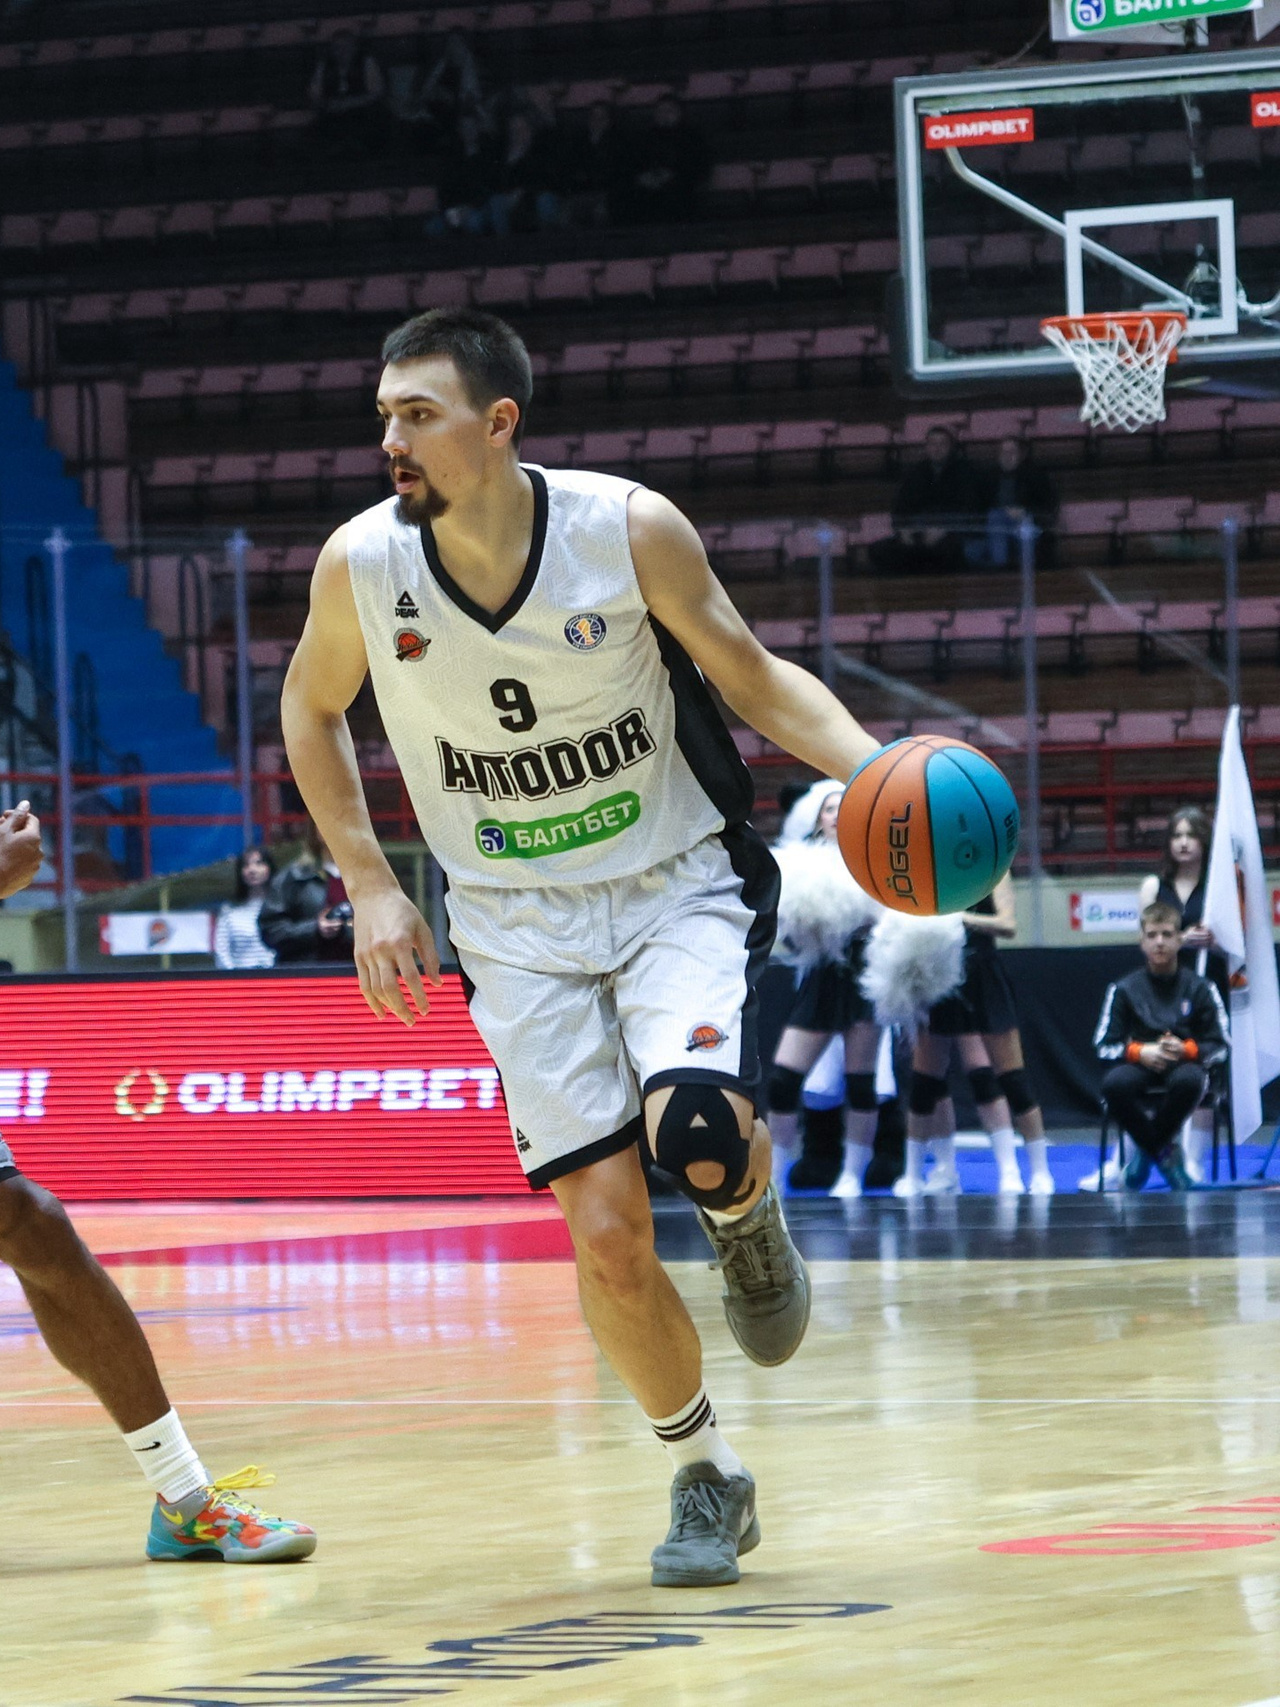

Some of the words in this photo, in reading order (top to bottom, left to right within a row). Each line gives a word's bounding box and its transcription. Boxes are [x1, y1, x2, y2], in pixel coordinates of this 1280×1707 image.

[928, 117, 1030, 140] OLIMPBET
[395, 607, 420, 619] PEAK
[489, 678, 538, 733] 9
[514, 801, 633, 849] БАЛТБЕТ
[886, 802, 919, 906] JÖGEL
[178, 1068, 499, 1112] OLIMPBET
